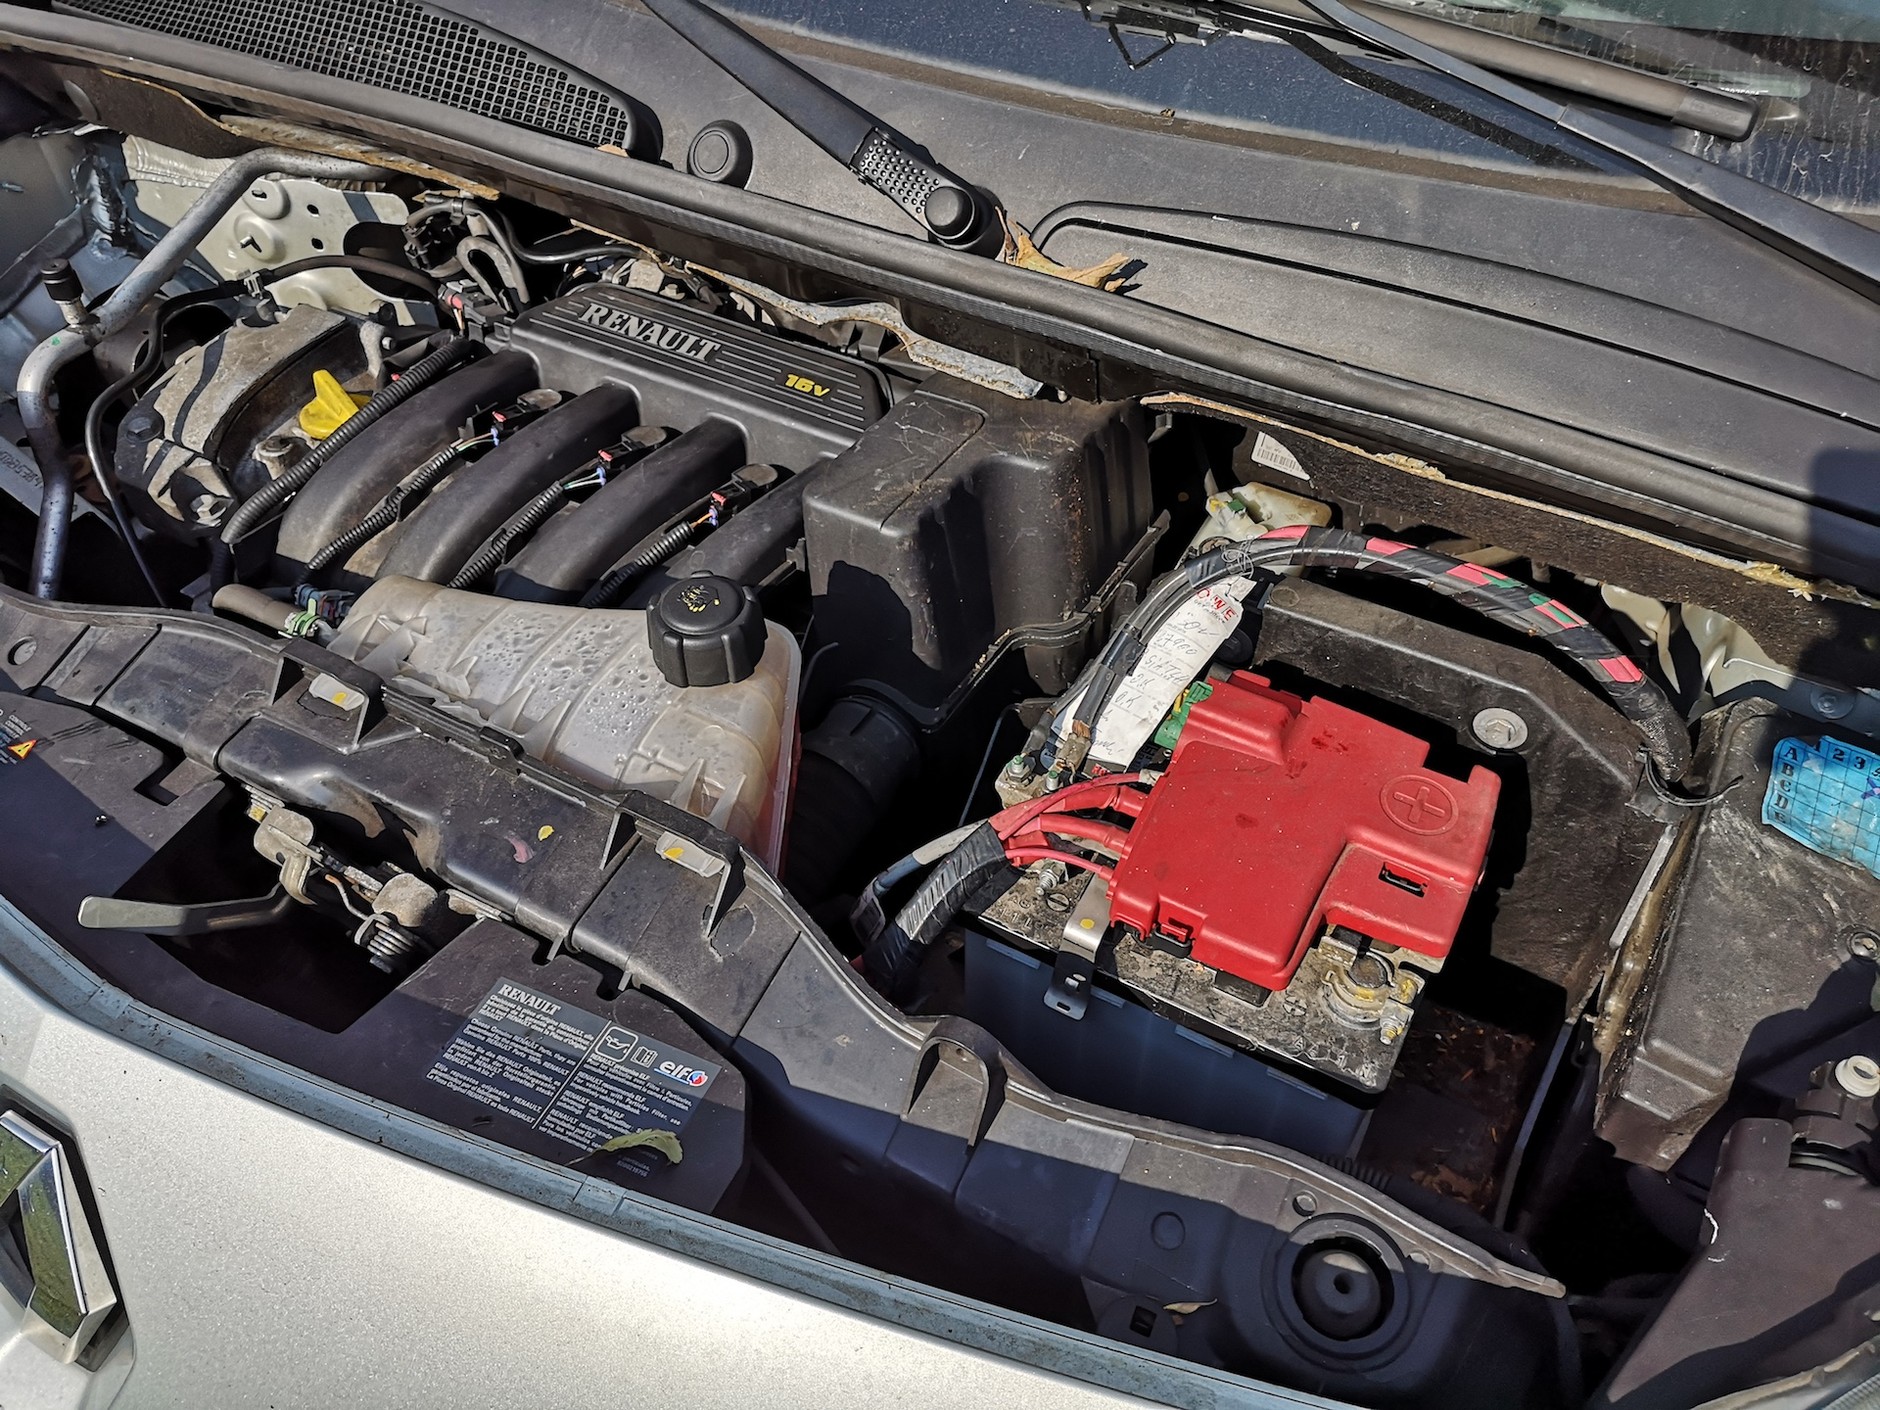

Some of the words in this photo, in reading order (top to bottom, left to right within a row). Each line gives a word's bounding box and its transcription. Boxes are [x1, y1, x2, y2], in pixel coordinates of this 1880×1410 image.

[579, 303, 721, 361] RENAULT
[1784, 746, 1798, 761] A
[1833, 747, 1845, 762] 2
[1854, 755, 1866, 770] 3
[1781, 762, 1795, 777] B
[1780, 779, 1791, 792] C
[1775, 793, 1789, 809] D
[497, 983, 561, 1016] RENAULT
[477, 1008, 503, 1022] RENAULT
[505, 1013, 532, 1027] RENAULT
[511, 1034, 539, 1050] RENAULT
[442, 1051, 468, 1066] RENAULT
[484, 1036, 513, 1052] RENAULT
[541, 1061, 569, 1077] RENAULT
[495, 1054, 523, 1070] RENAULT
[589, 1052, 616, 1067] RENAULT
[473, 1058, 502, 1074] RENAULT
[576, 1070, 603, 1085] RENAULT
[563, 1089, 590, 1104] RENAULT
[465, 1089, 492, 1105] RENAULT
[507, 1108, 535, 1124] RENAULT
[549, 1108, 578, 1125] RENAULT
